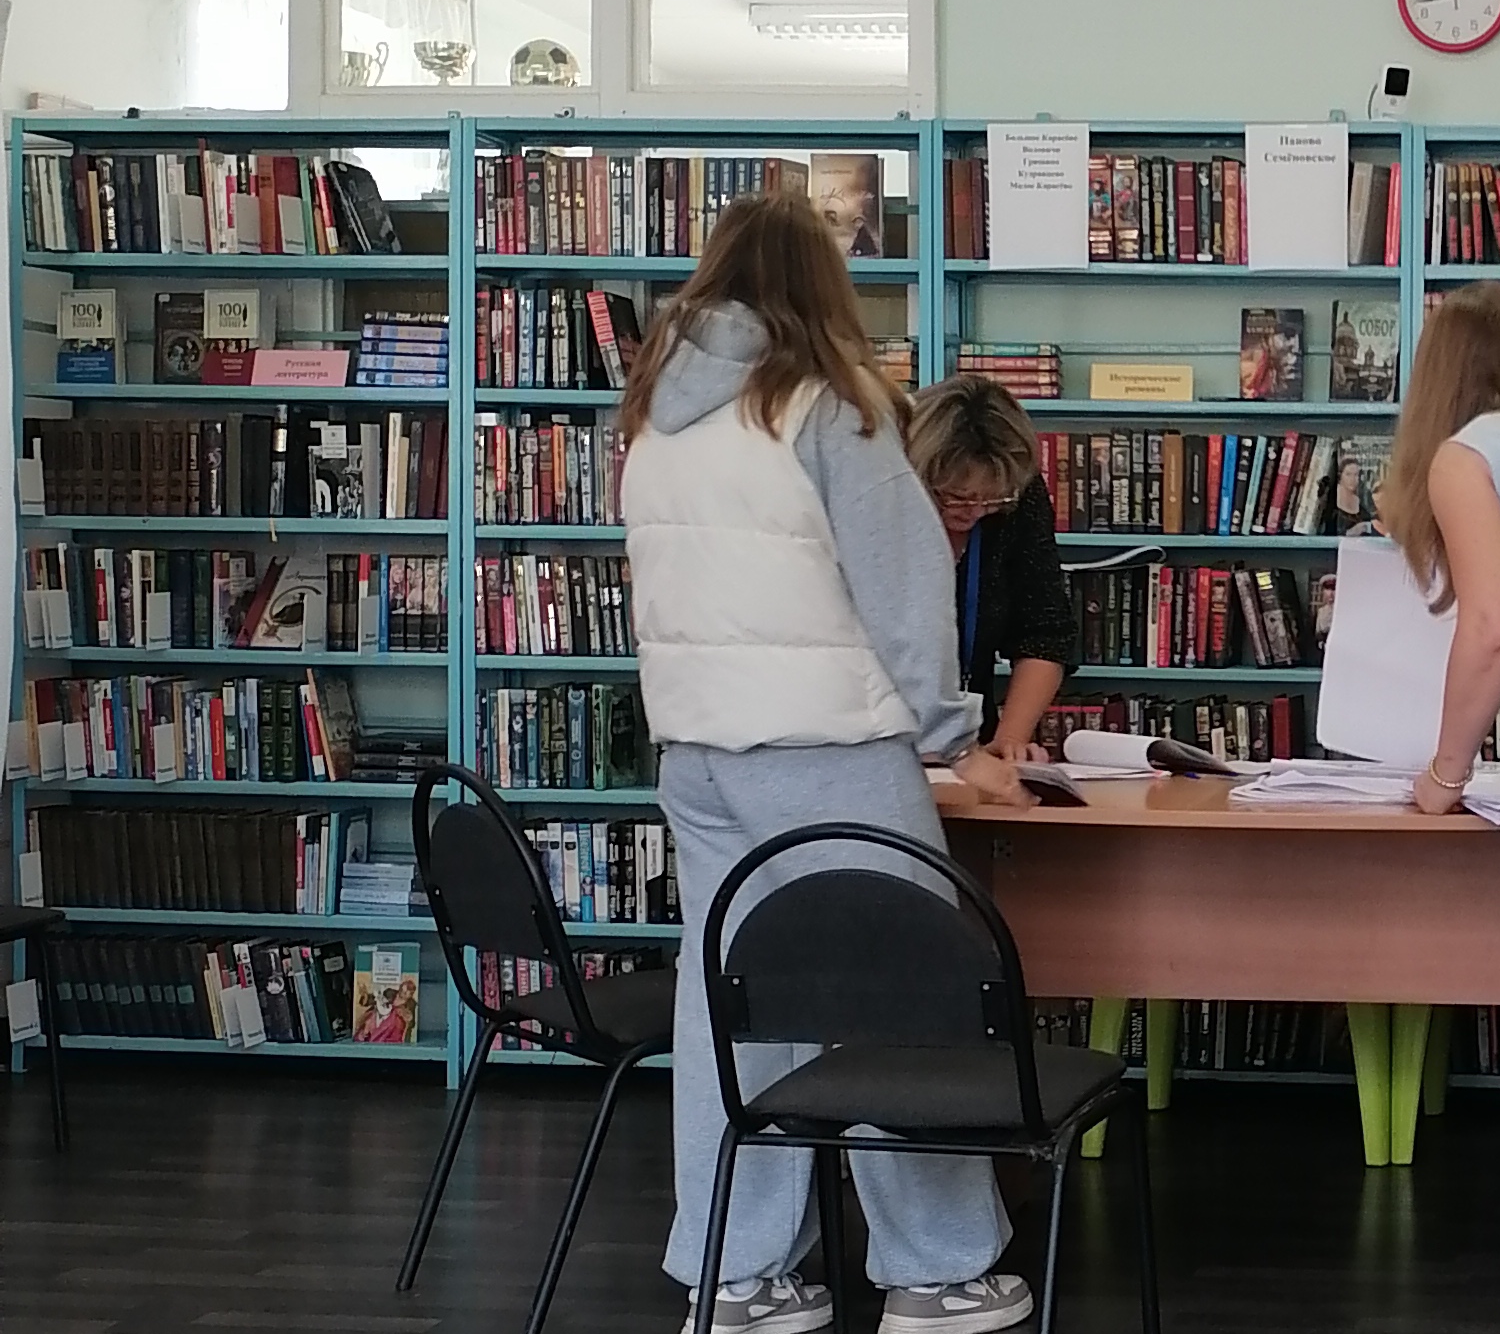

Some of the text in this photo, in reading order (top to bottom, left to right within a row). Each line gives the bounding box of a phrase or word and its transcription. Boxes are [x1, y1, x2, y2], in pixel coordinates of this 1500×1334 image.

[1483, 5, 1492, 16] 4
[1435, 20, 1443, 32] 7
[1469, 19, 1479, 31] 5
[1451, 26, 1461, 38] 6
[70, 303, 96, 317] 100
[217, 302, 242, 316] 100
[284, 359, 322, 368] Русская
[274, 371, 329, 380] литература
